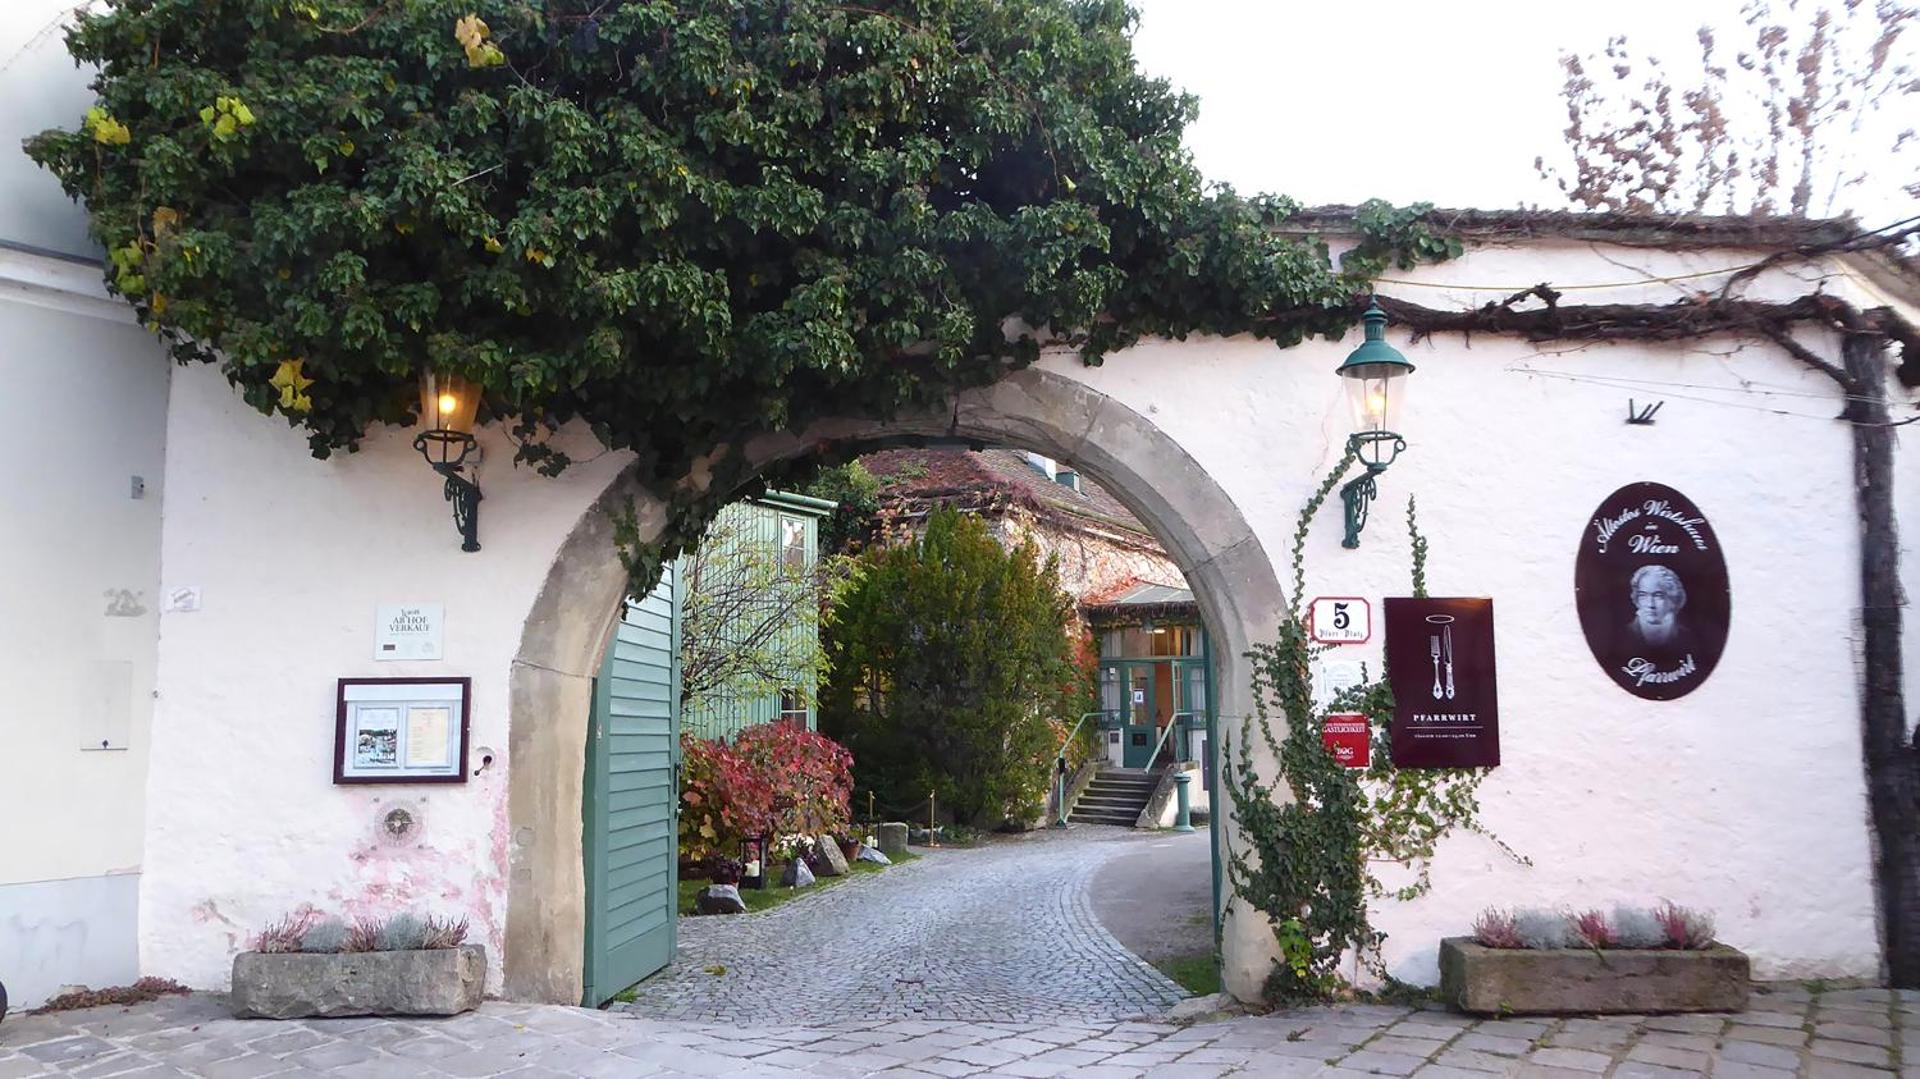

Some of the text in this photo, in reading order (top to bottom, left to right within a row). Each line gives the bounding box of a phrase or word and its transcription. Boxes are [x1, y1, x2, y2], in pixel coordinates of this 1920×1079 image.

[1643, 500, 1708, 550] Wirtshaus
[1628, 535, 1680, 554] Wien
[1334, 603, 1350, 629] 5
[1621, 653, 1696, 687] Pfarrwirt
